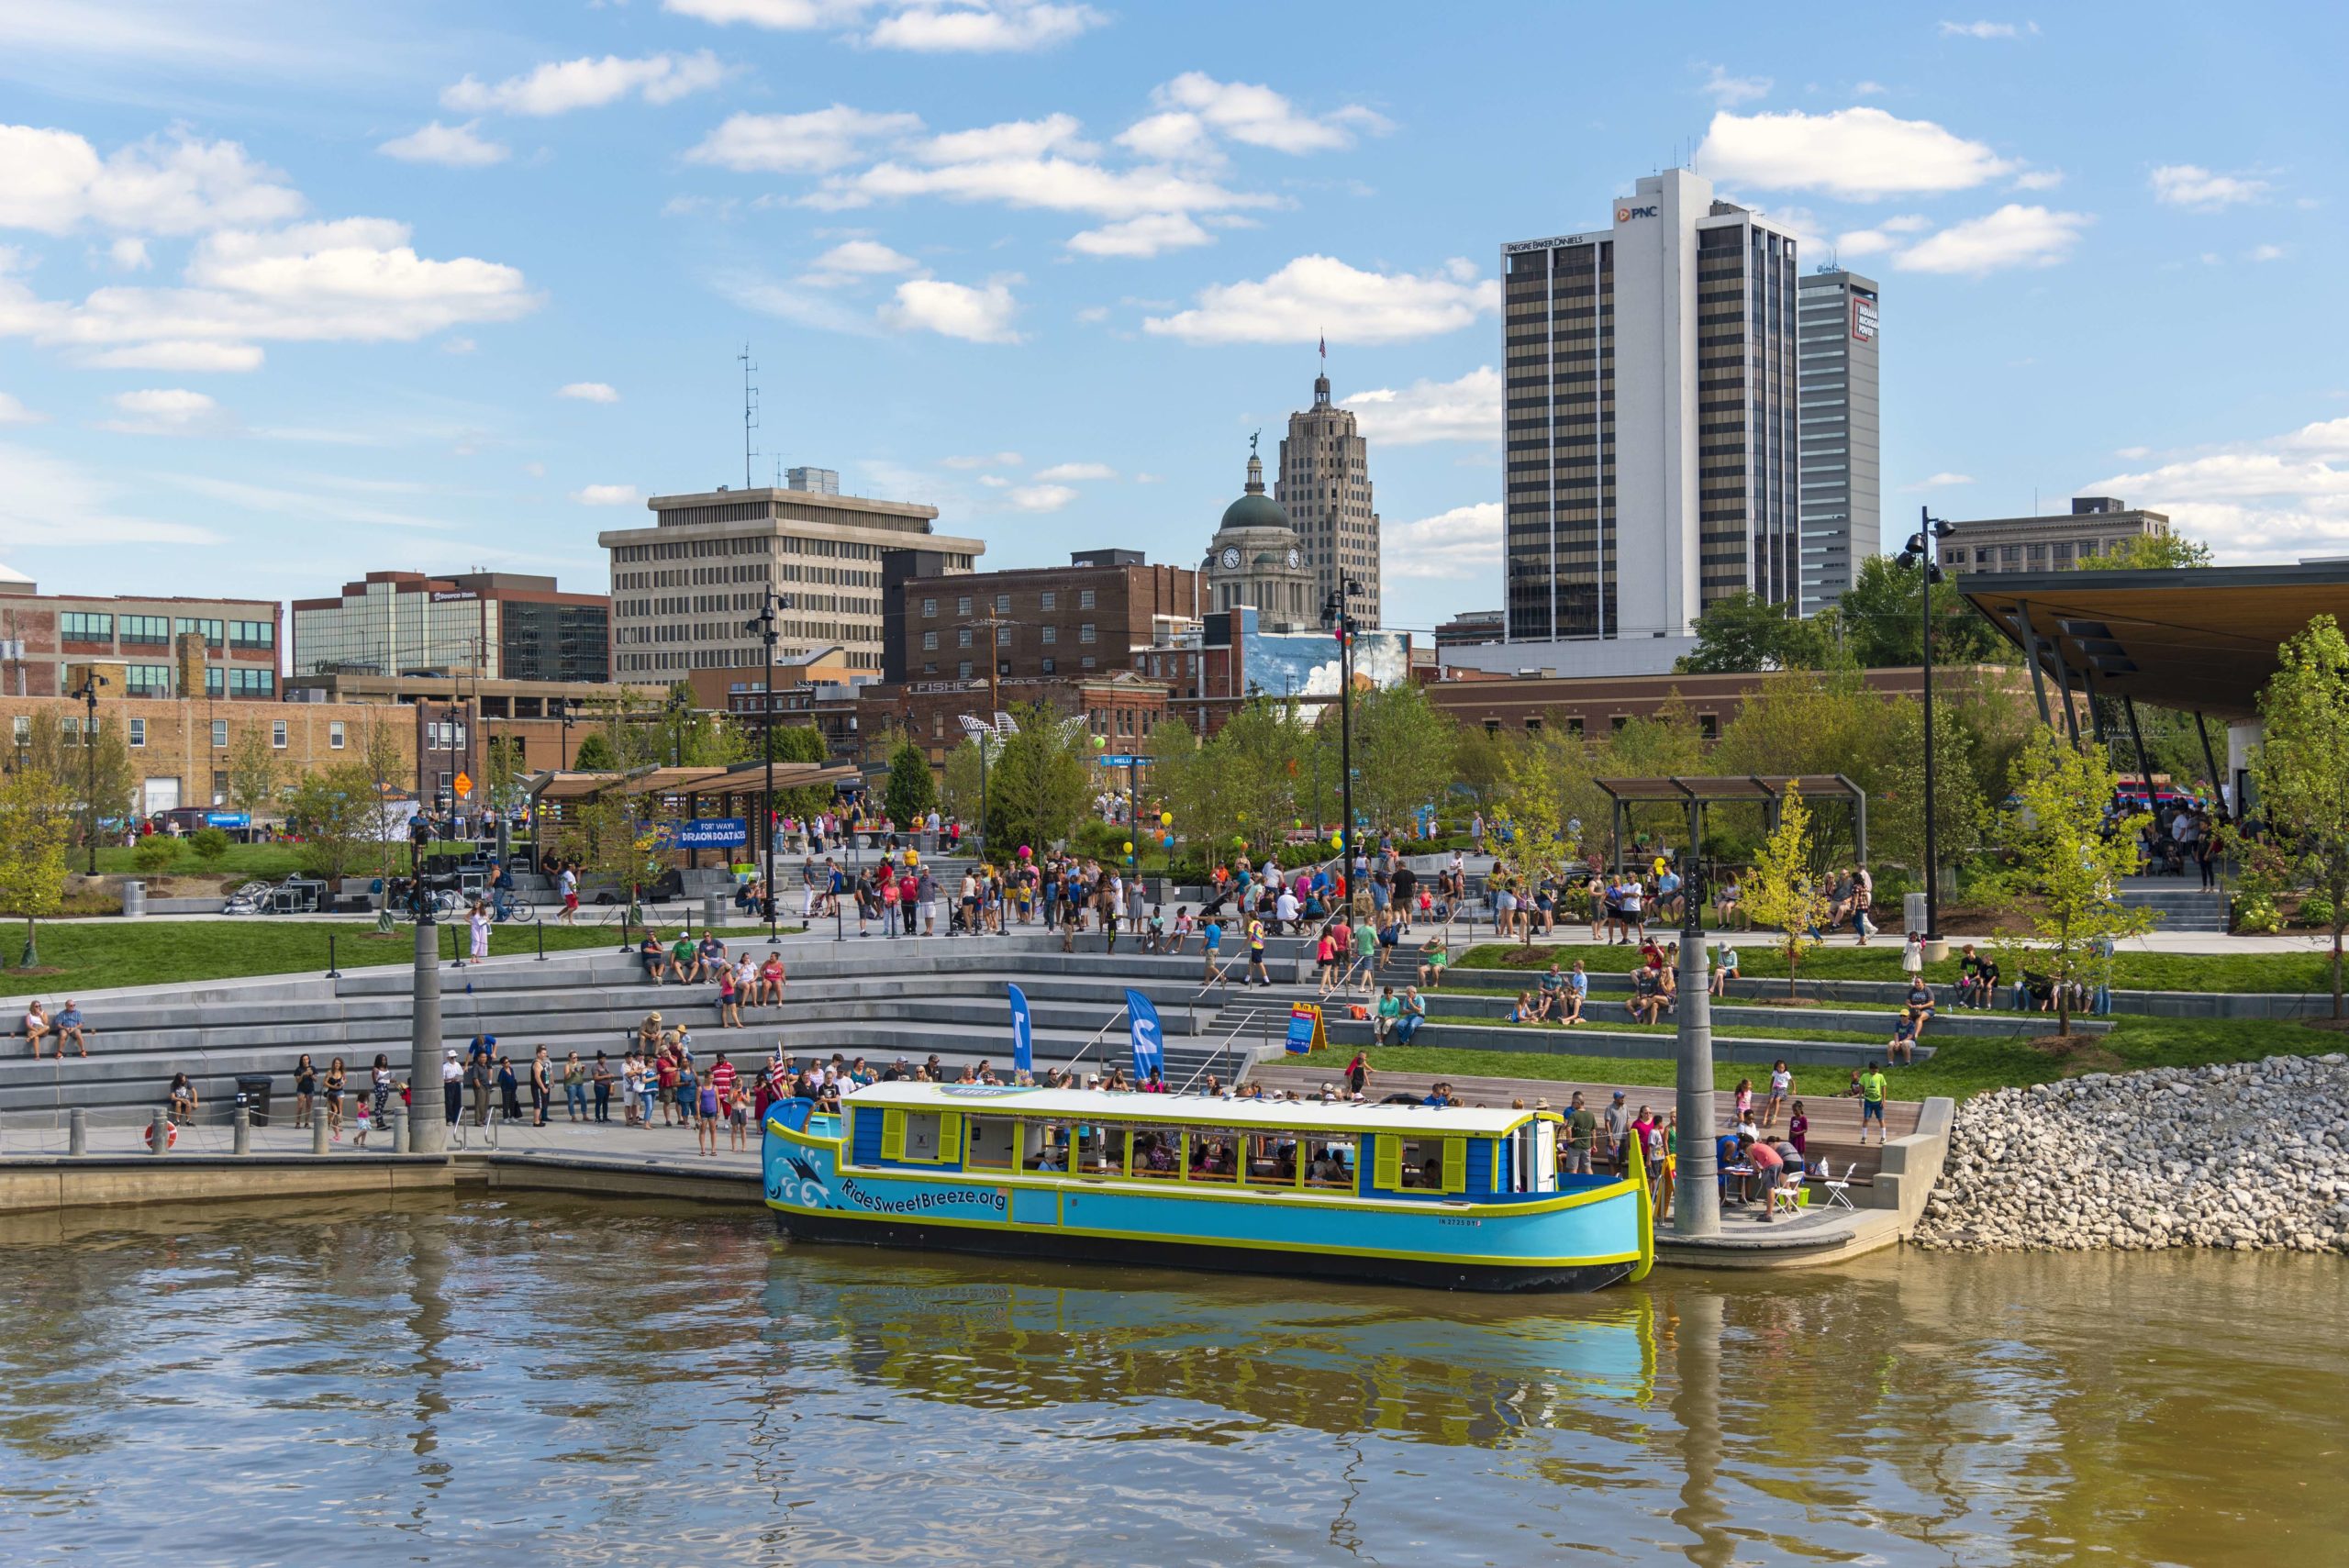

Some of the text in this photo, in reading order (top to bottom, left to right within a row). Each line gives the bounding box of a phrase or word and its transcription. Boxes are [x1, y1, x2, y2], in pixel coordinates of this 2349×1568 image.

[1631, 206, 1658, 219] PNC
[1508, 236, 1583, 252] FAEGRE BAKER DANIELS
[1859, 306, 1877, 320] INDIANA
[1858, 324, 1874, 338] POWER
[917, 682, 975, 693] FISHE
[716, 822, 735, 830] WAYN
[952, 1088, 1001, 1096] RIVERS
[841, 1178, 1007, 1213] RideSweetBreeze.org
